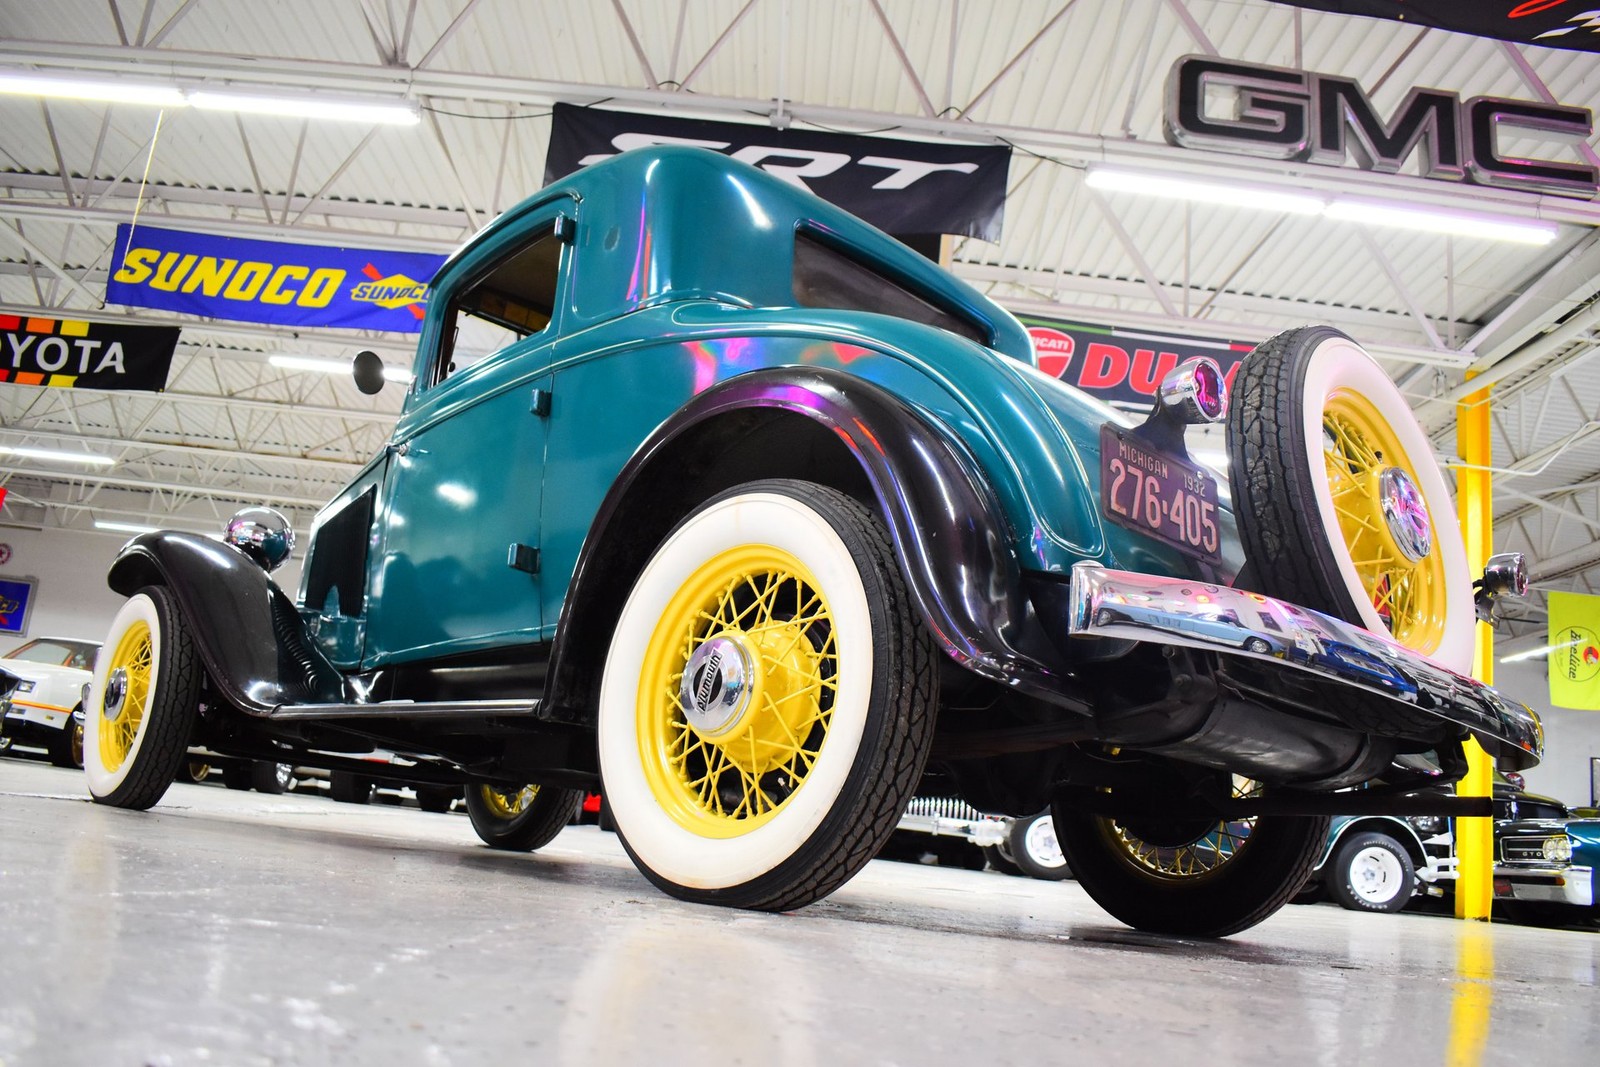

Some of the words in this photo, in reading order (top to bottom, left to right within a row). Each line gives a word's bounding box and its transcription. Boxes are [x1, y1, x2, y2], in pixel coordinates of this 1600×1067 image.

[1163, 54, 1600, 200] GMC
[113, 247, 347, 309] SUNOCO
[0, 332, 126, 374] YOTA
[1033, 336, 1069, 351] UCATI
[1119, 441, 1168, 479] MICHIGAN
[1183, 473, 1205, 497] 1932
